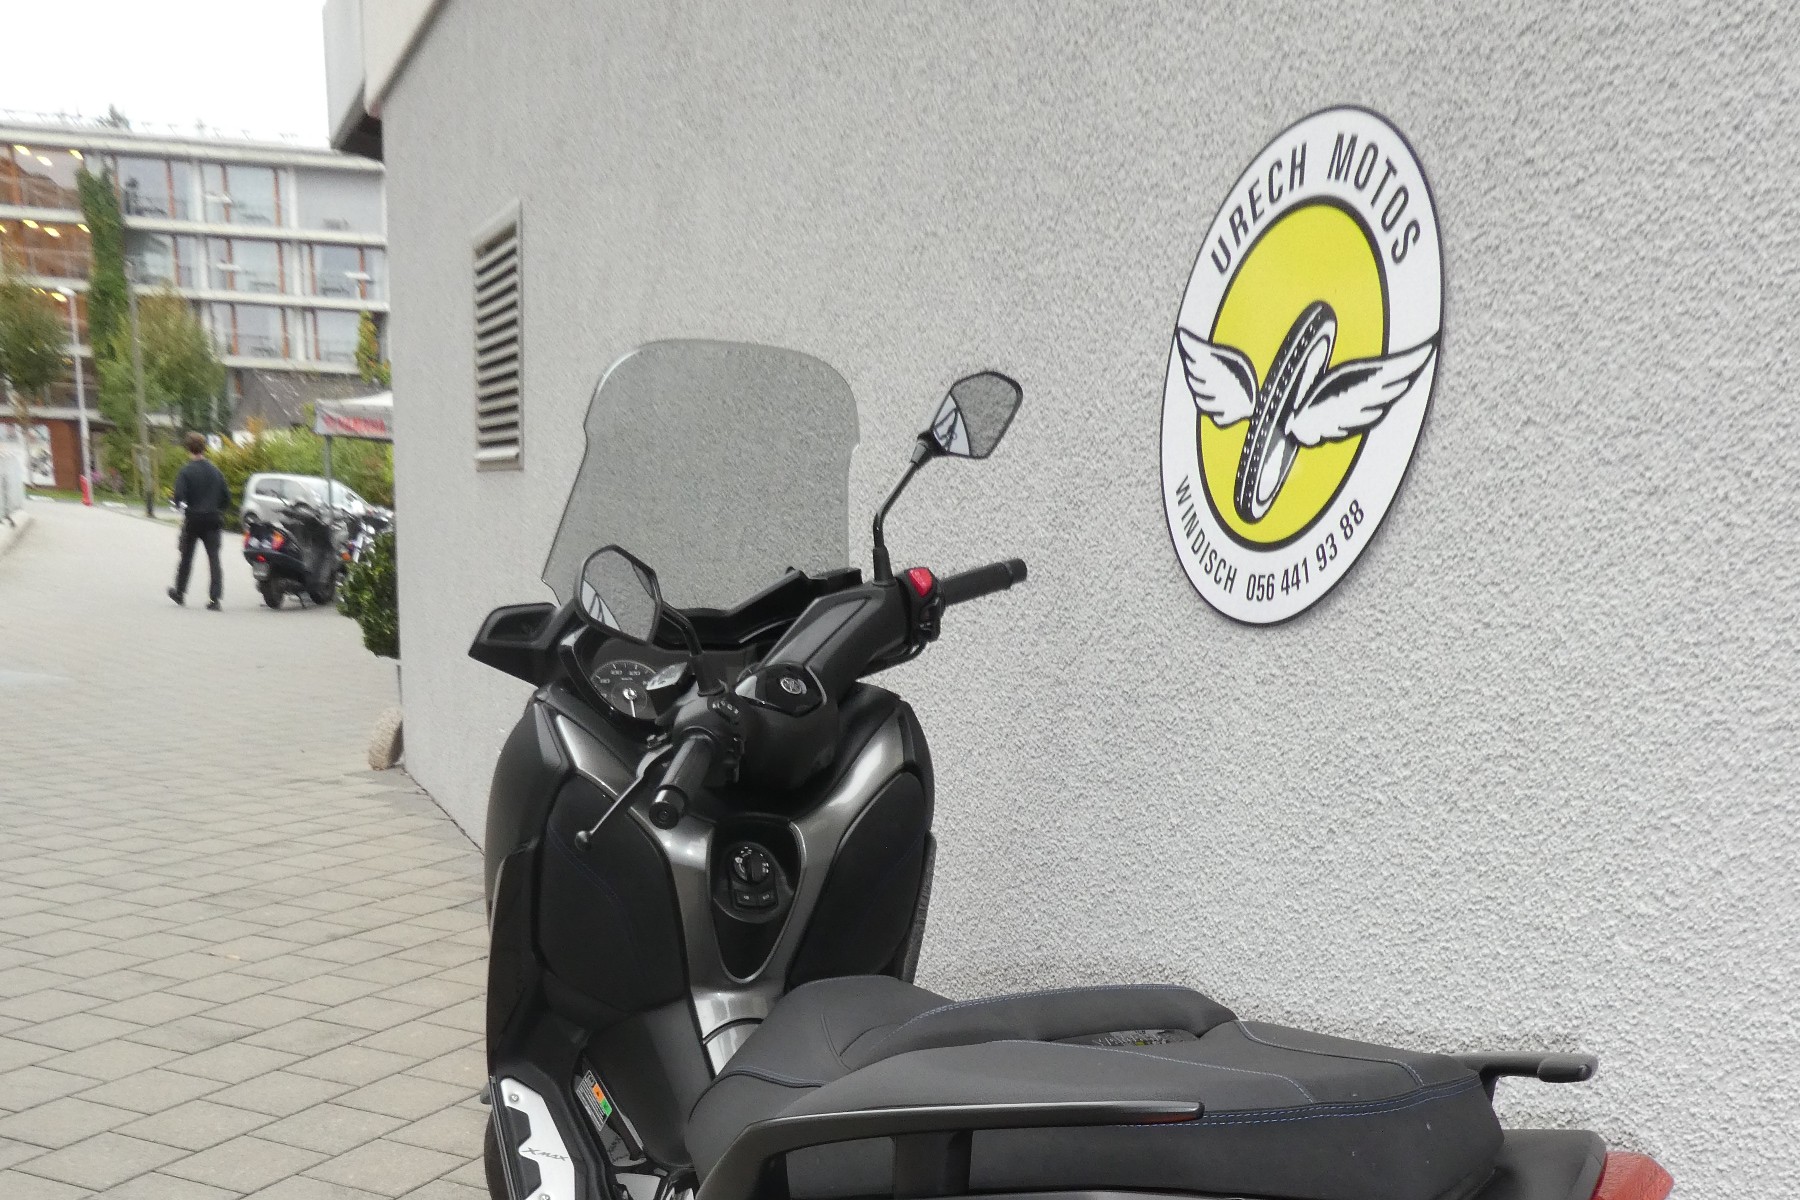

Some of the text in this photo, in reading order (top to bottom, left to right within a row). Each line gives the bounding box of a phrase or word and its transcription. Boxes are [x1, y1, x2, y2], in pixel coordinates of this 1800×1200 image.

[1211, 133, 1420, 275] URECH MOTOS
[1176, 475, 1364, 601] WINDISCH 056 441 93 88
